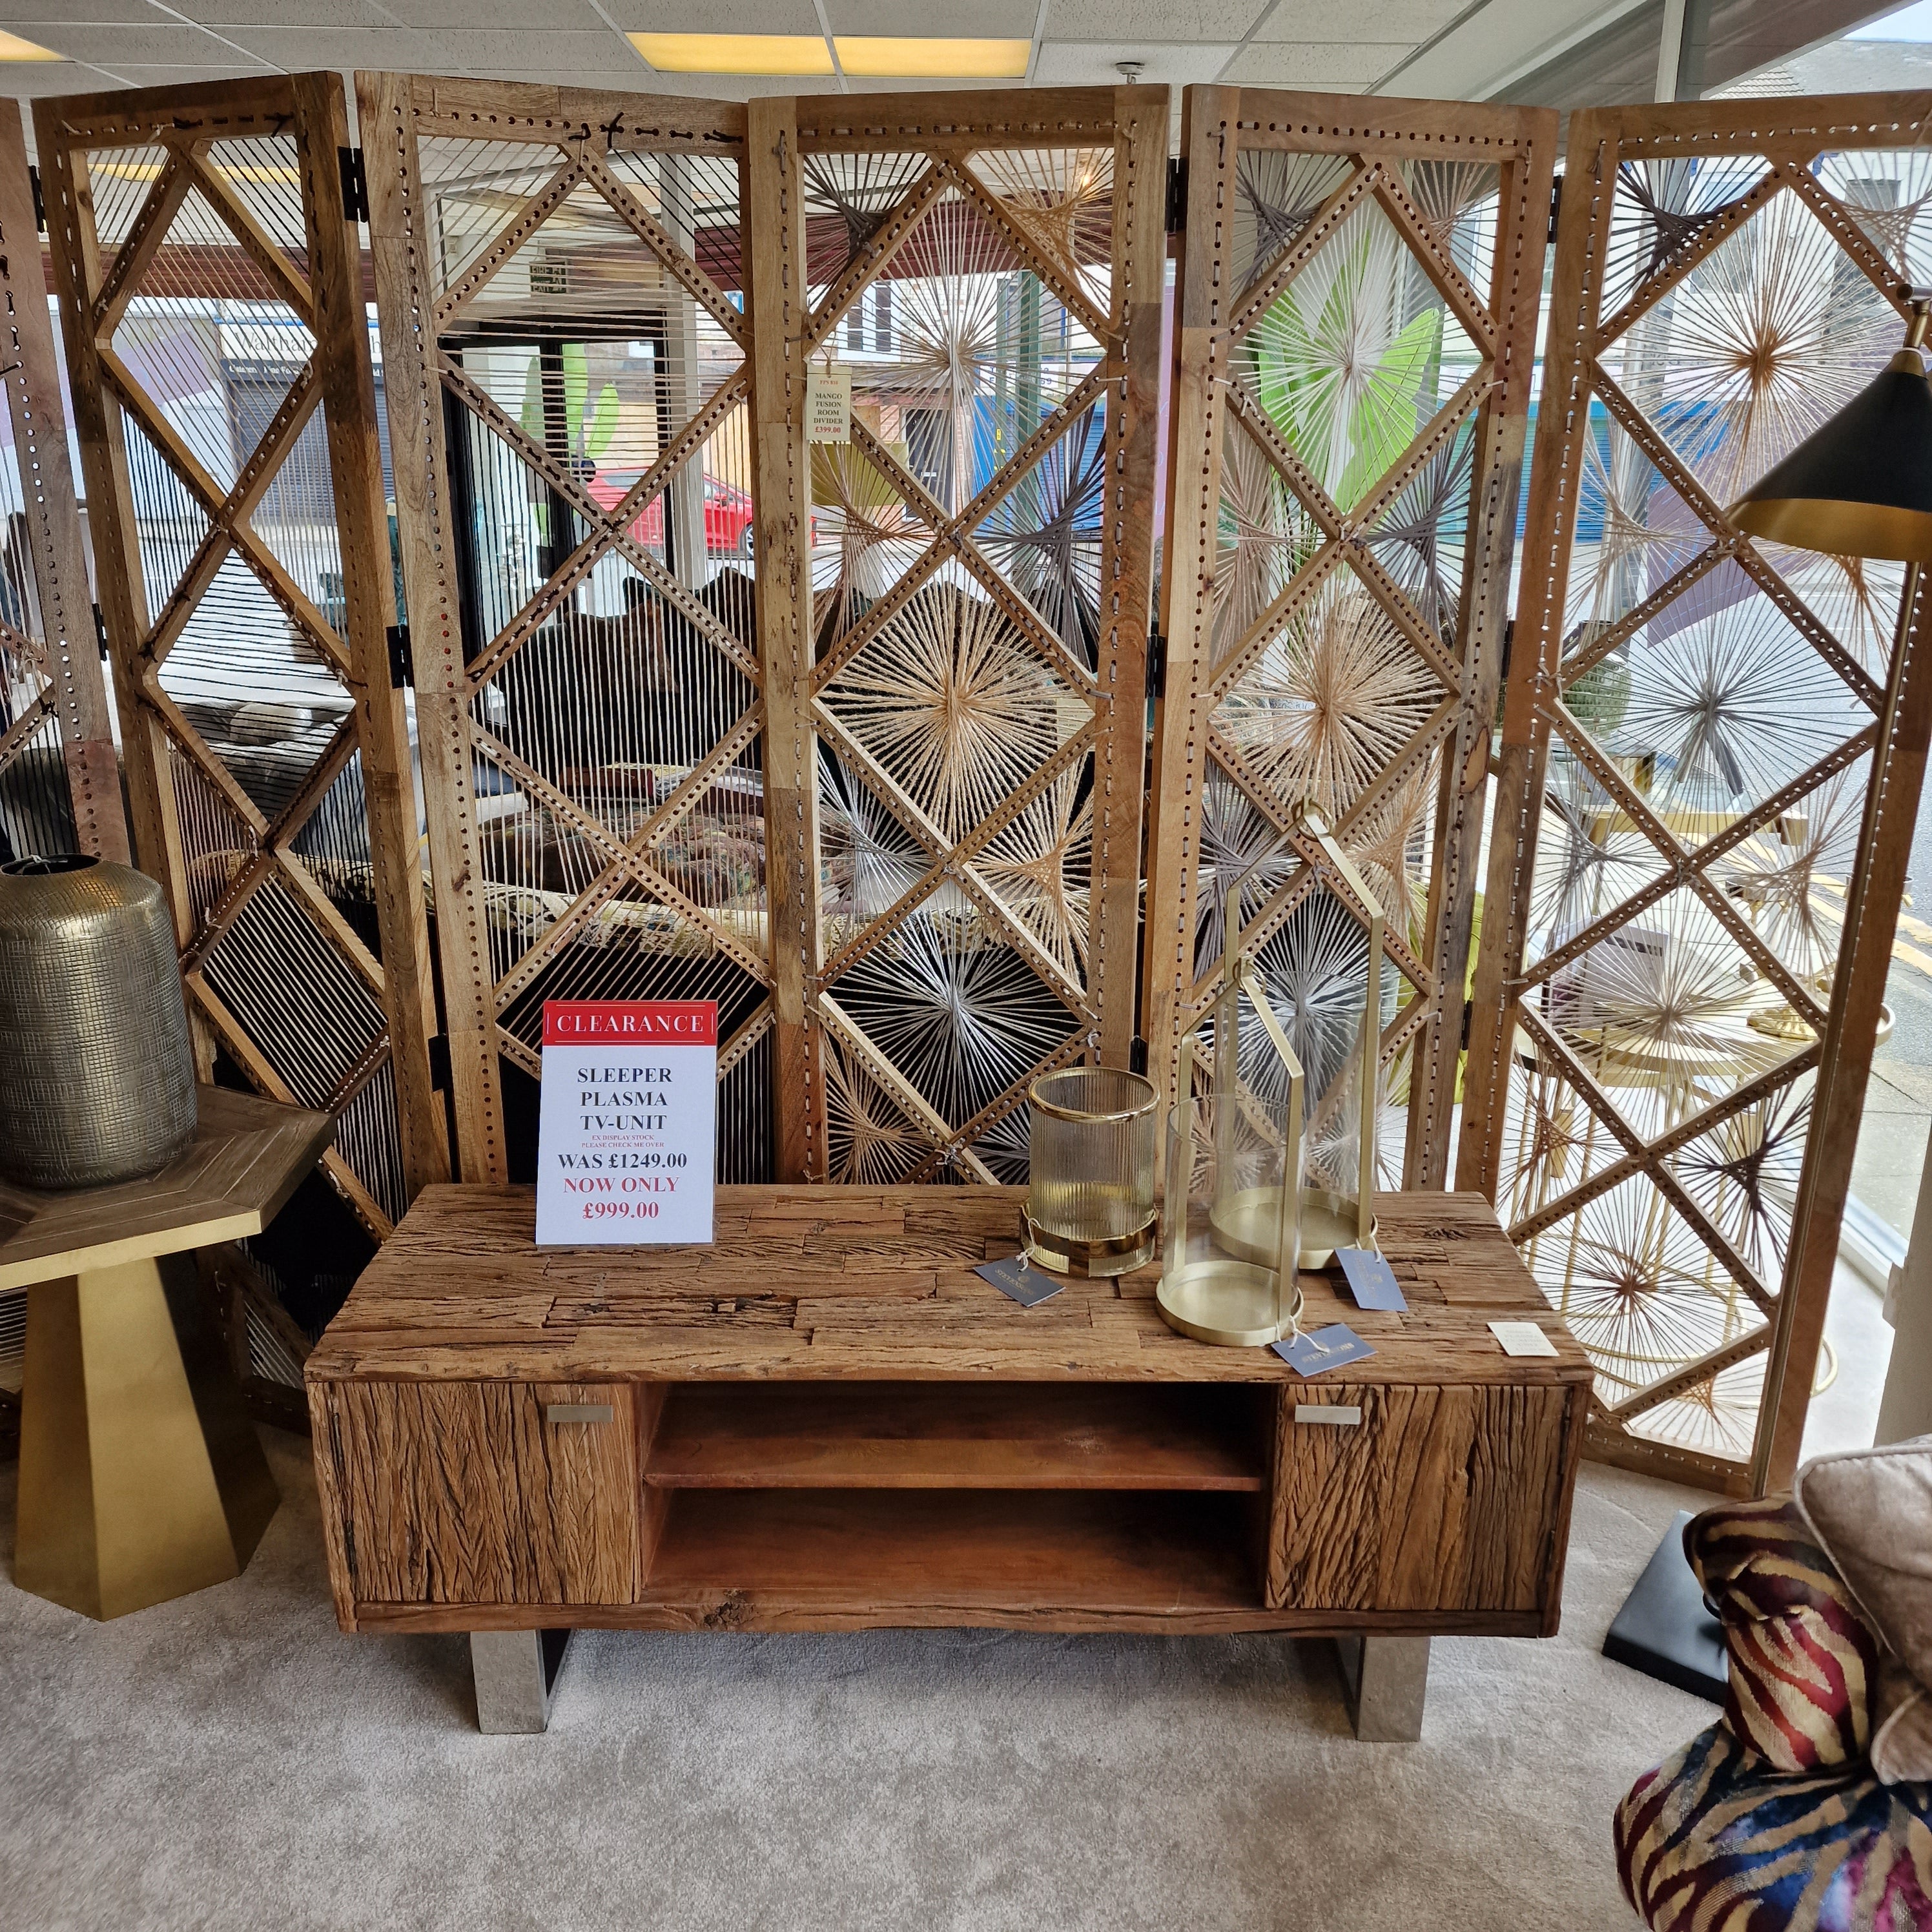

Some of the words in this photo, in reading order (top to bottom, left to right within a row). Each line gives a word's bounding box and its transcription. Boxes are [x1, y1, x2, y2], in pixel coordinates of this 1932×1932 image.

[557, 1014, 704, 1033] CLEARANCE
[577, 1067, 673, 1083] SLEEPER
[580, 1091, 668, 1106] PLASMA
[580, 1115, 668, 1130] TV-UNIT
[558, 1153, 602, 1169] WAS
[608, 1153, 687, 1168] £1249.00
[563, 1178, 616, 1193] NOW
[621, 1177, 681, 1193] ONLY
[582, 1201, 659, 1219] £999.00
